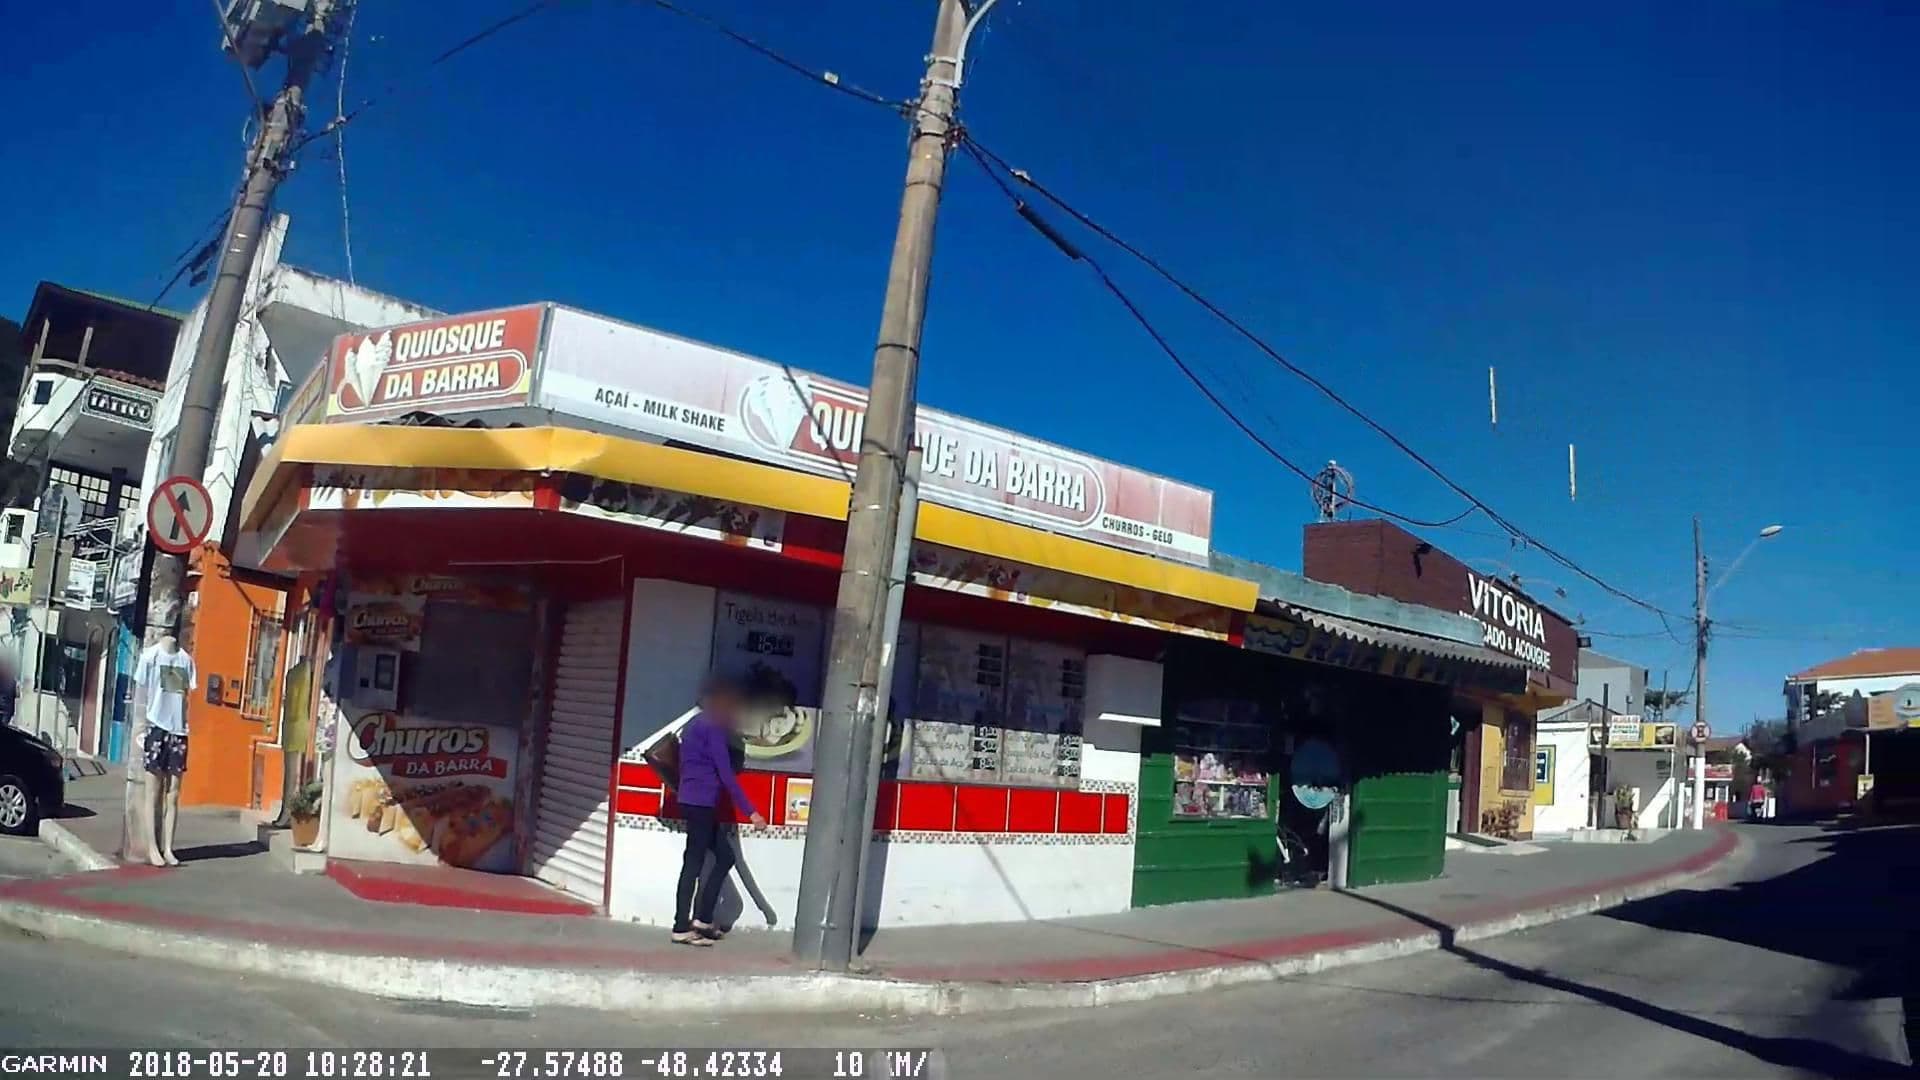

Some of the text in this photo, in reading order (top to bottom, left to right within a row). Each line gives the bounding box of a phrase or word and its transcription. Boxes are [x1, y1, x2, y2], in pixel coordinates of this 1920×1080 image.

[395, 319, 507, 363] QUIOSQUE
[384, 360, 500, 400] DA BARRA
[594, 387, 629, 409] AÇAÍ
[643, 399, 678, 422] MILK
[680, 408, 726, 433] SHAKE
[963, 449, 999, 490] DA
[1006, 455, 1087, 513] BARRA
[1102, 516, 1145, 538] CHURROS
[1152, 528, 1174, 545] GELO
[348, 713, 488, 760] Churros
[406, 758, 494, 776] DA BARRA
